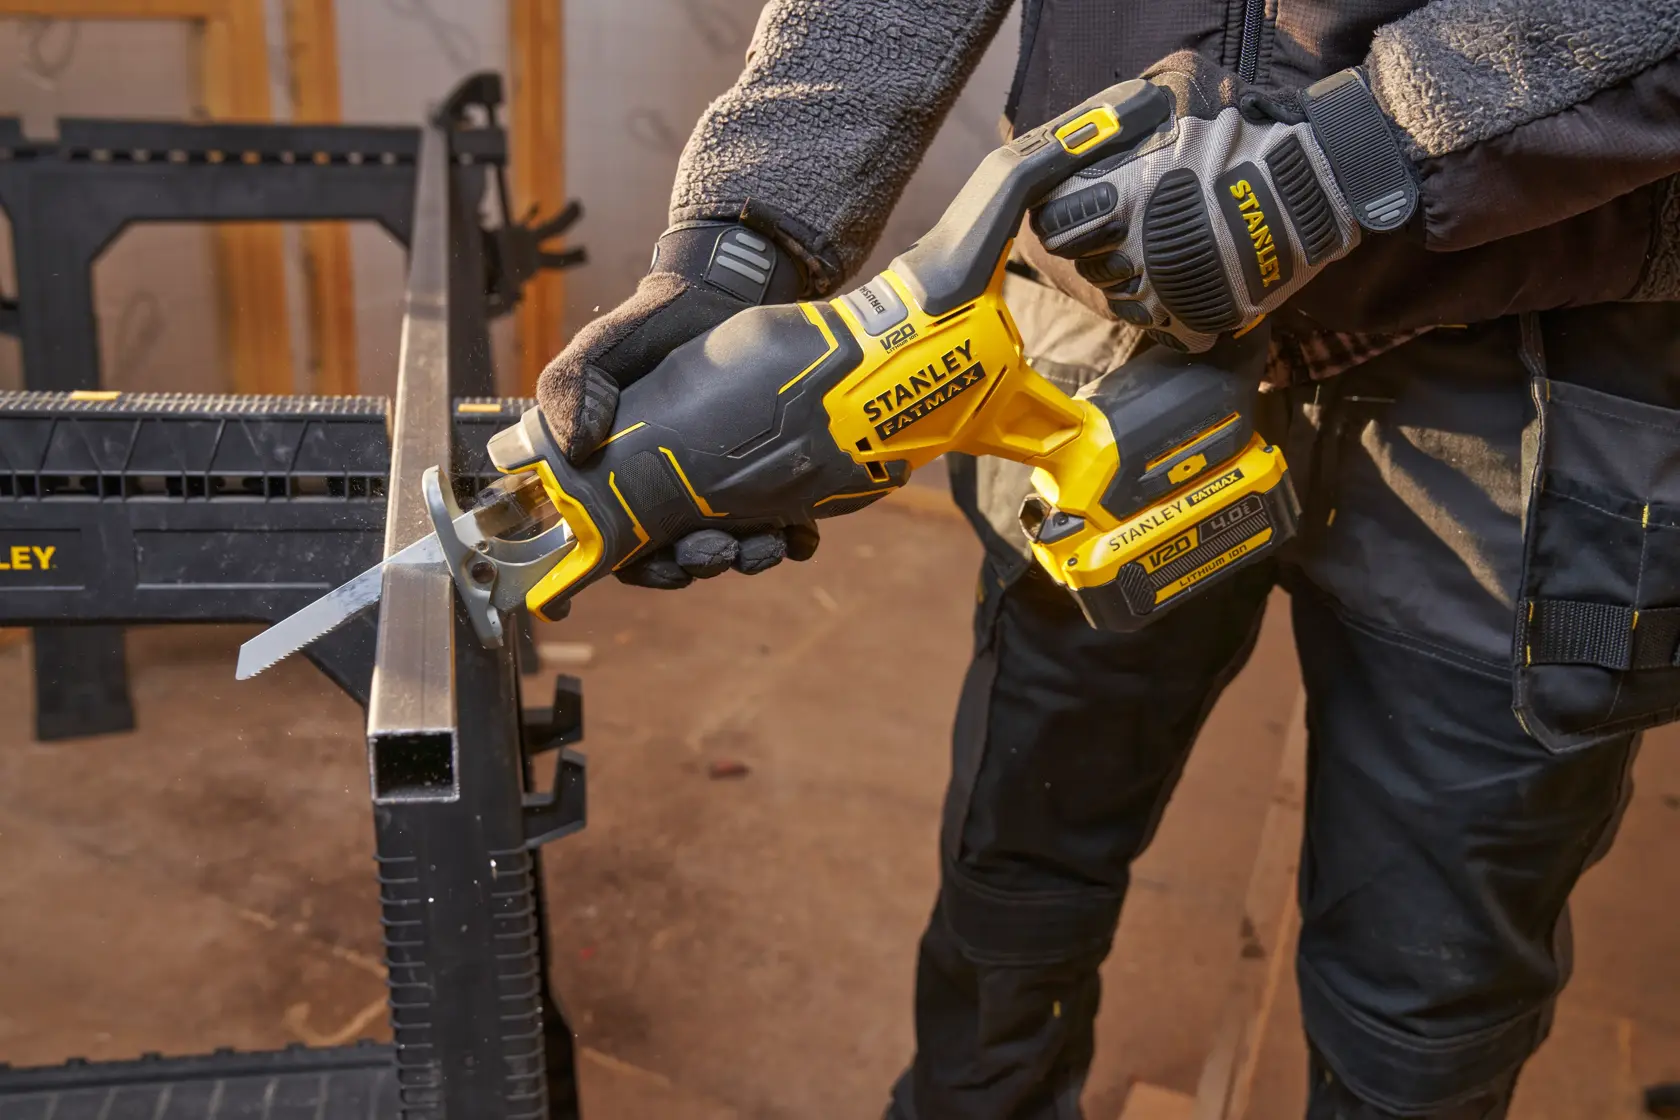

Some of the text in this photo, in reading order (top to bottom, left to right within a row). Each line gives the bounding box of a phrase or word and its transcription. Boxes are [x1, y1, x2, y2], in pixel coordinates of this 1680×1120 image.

[1230, 180, 1280, 287] STANLEY
[880, 323, 915, 350] V20
[863, 339, 972, 422] STANLEY
[883, 369, 978, 435] FATMAX
[1108, 473, 1239, 551] STANLEY FATMAX
[1149, 536, 1191, 568] V20
[1179, 544, 1248, 587] LITHIUM ION
